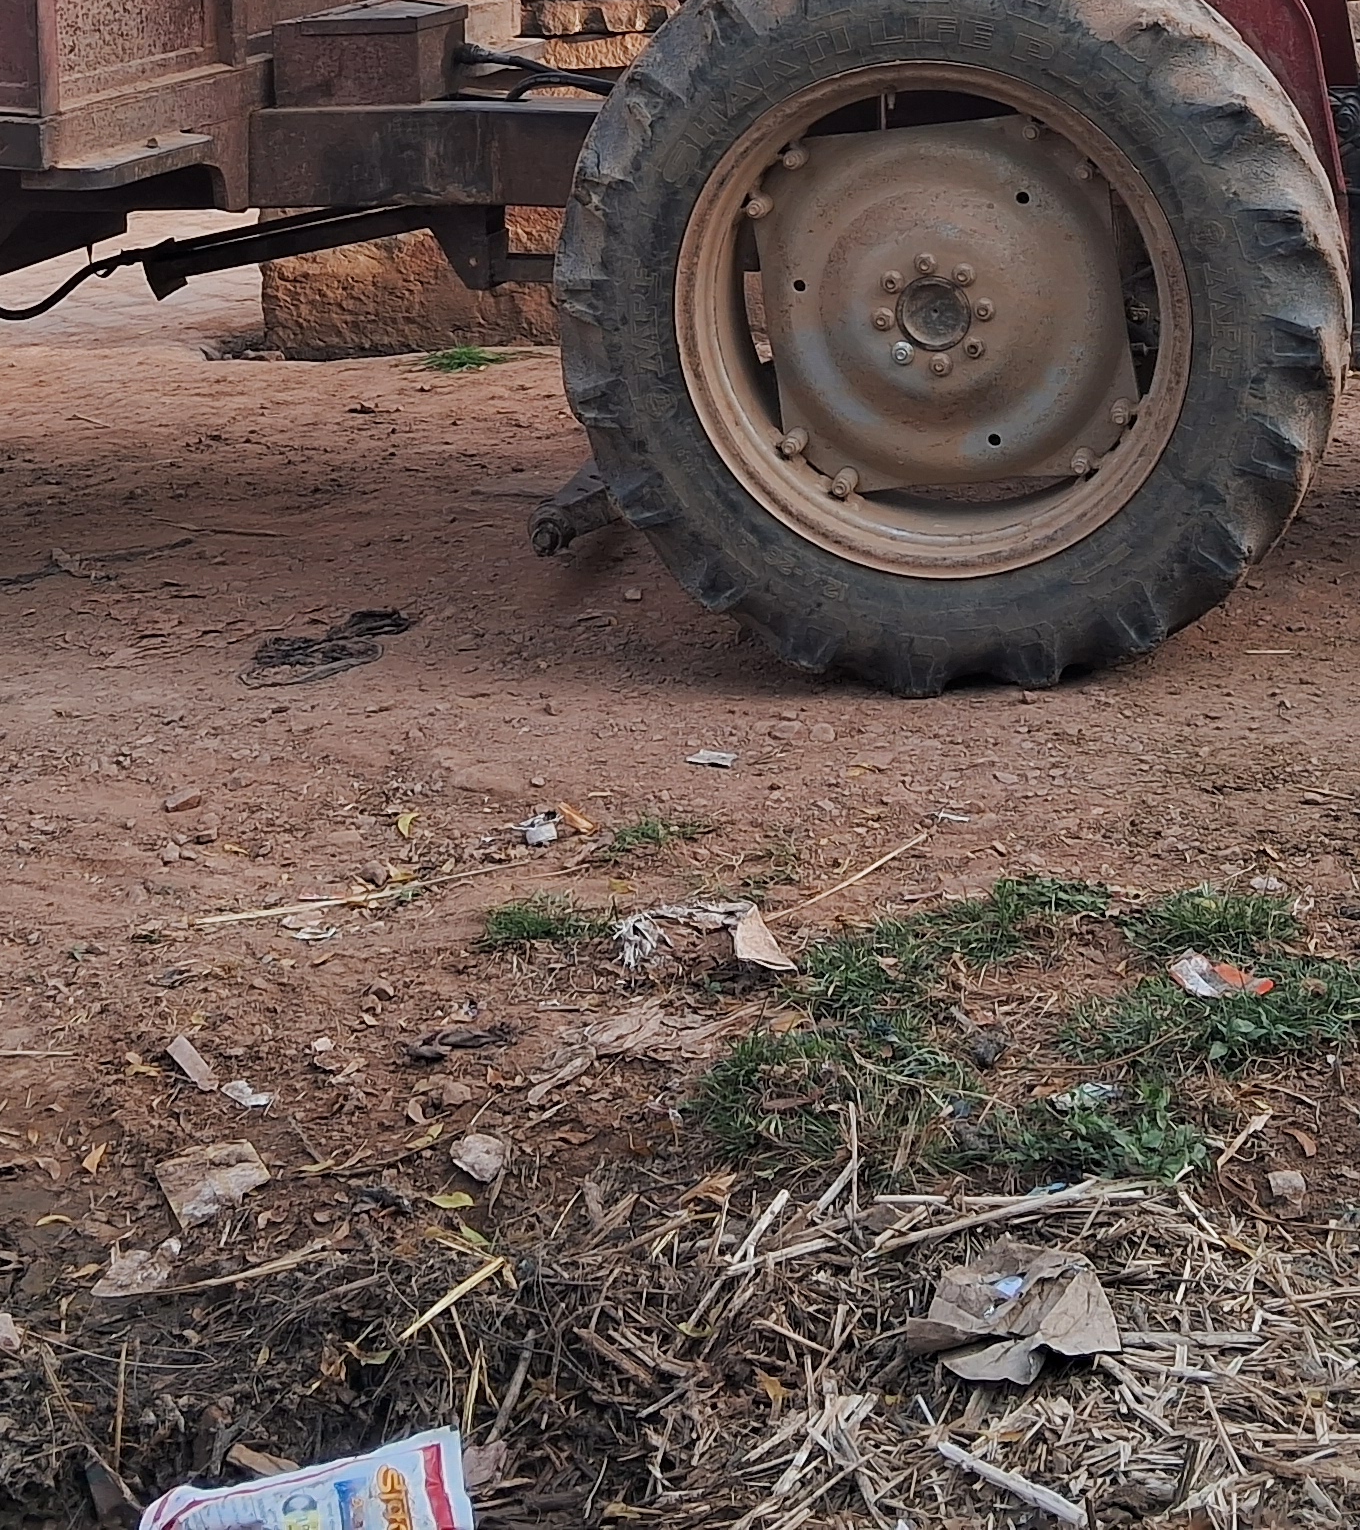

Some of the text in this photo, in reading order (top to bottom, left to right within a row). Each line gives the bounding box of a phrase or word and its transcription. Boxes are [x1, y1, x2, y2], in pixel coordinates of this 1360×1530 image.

[662, 25, 852, 187] SHAKTI
[869, 15, 995, 51] LIFE
[1203, 261, 1243, 378] MRF
